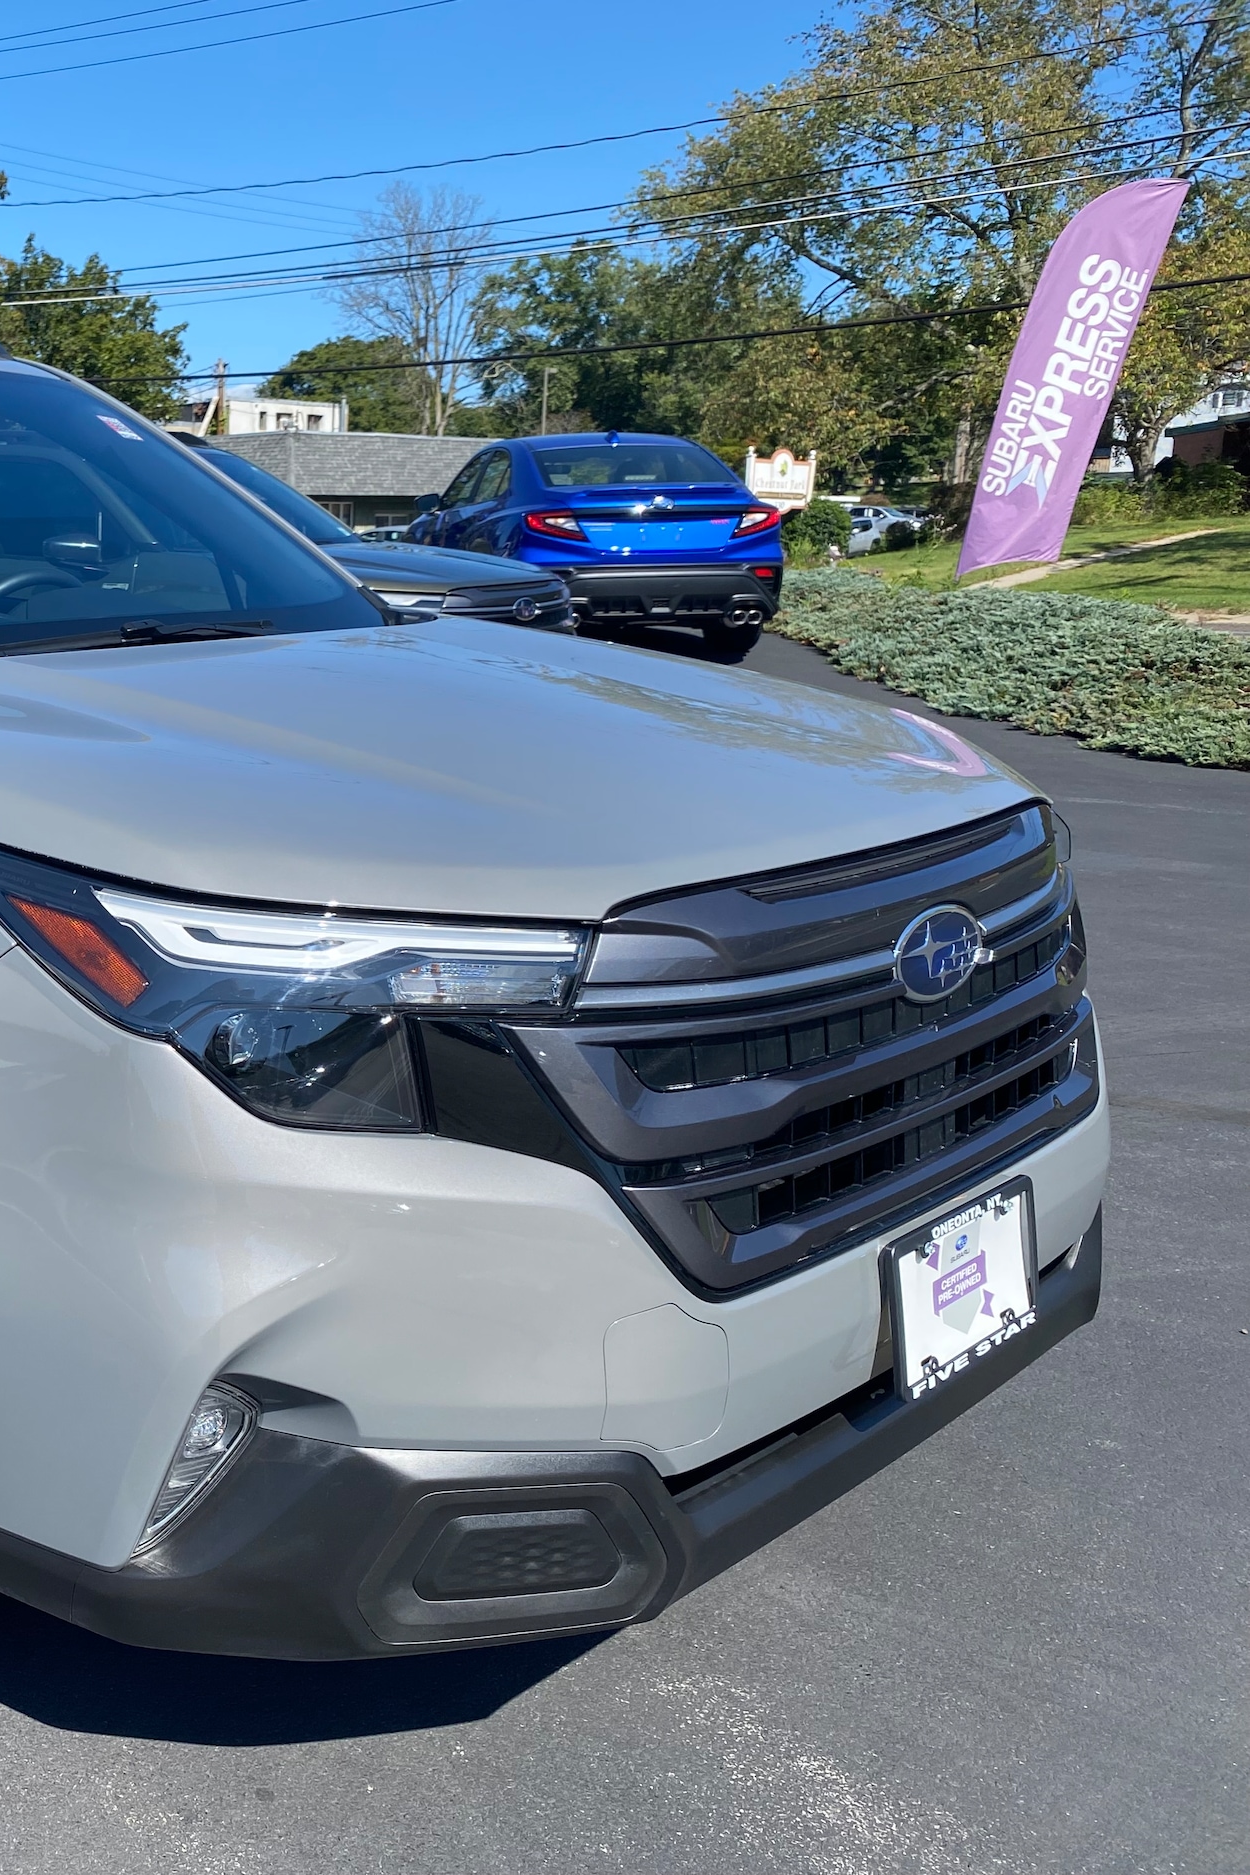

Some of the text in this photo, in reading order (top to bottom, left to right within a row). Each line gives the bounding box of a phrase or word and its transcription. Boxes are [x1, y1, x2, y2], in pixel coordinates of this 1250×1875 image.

[1009, 253, 1123, 494] EXPRESS
[982, 380, 1037, 496] SUBARU
[940, 1262, 978, 1291] CERTIFIED
[950, 1249, 971, 1263] SUBARU
[938, 1273, 981, 1305] PRE-OWNED
[911, 1311, 1037, 1400] FIVE STAR
